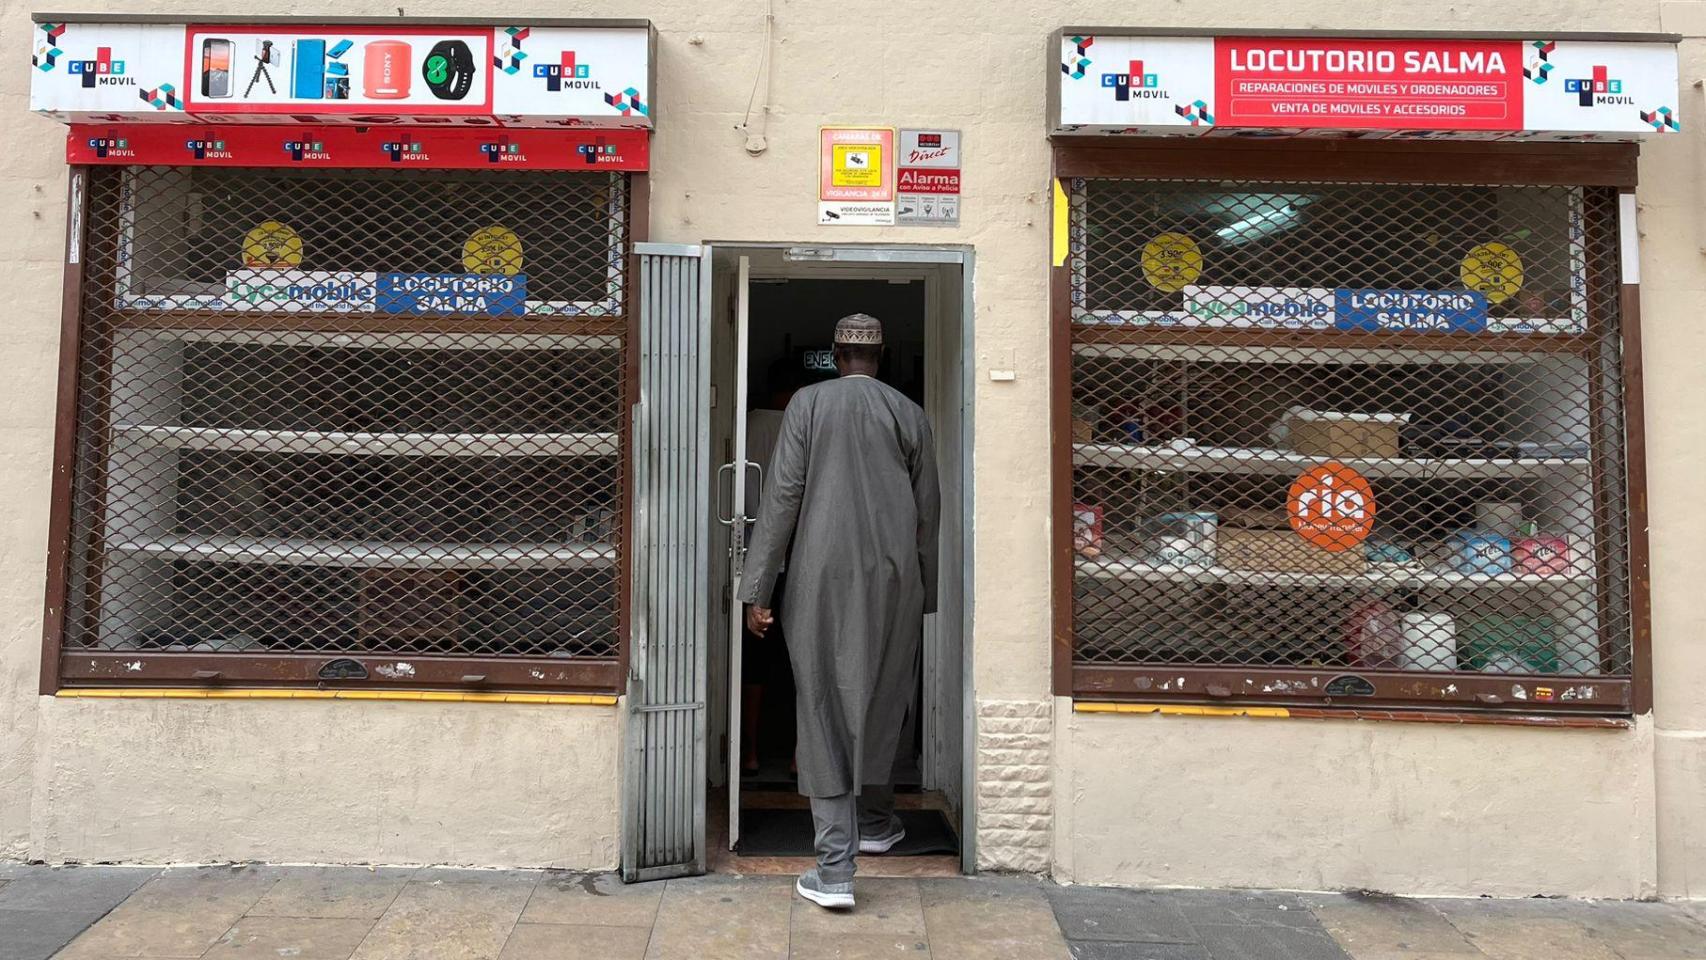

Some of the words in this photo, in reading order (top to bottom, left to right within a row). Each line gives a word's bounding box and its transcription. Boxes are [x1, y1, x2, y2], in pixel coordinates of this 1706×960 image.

[1230, 49, 1396, 73] LOCUTORIO
[1404, 51, 1507, 75] SALMA
[70, 62, 122, 73] CUBE
[383, 52, 391, 84] SONY
[536, 66, 587, 76] CUBE
[99, 77, 136, 86] MOVIL
[564, 81, 601, 90] MOVIL
[1104, 76, 1155, 86] CUBE
[1567, 81, 1619, 91] CUBE
[1239, 82, 1326, 94] REPARACIONES
[1329, 83, 1344, 94] DE
[1347, 83, 1399, 95] MOVILES
[1401, 84, 1408, 95] Y
[1410, 84, 1498, 96] ORDENADORES
[1132, 90, 1170, 99] MOVIL
[1596, 96, 1635, 105] MOVIL
[1271, 103, 1310, 114] VENTA
[1312, 103, 1327, 114] DE
[1330, 104, 1381, 115] MOVILES
[1383, 104, 1390, 115] Y
[1393, 104, 1466, 116] ACCESORIOS
[89, 139, 125, 147] CUBE
[186, 141, 223, 149] CUBE
[284, 142, 321, 151] CUBE
[383, 143, 419, 151] CUBE
[480, 144, 517, 153] CUBE
[578, 145, 614, 154] CUBE
[402, 153, 430, 161] MOVIL
[501, 154, 527, 163] MOVIL
[908, 146, 951, 163] Direct
[900, 170, 959, 185] Alarma
[392, 275, 514, 293] LOCUTORIO
[231, 279, 372, 304] Lycamobile
[416, 295, 488, 311] SALMA
[1351, 292, 1474, 310] LOCUTORIO
[1190, 297, 1329, 320] Lycamobile
[1377, 312, 1450, 329] SALMA
[1298, 473, 1364, 519] ria
